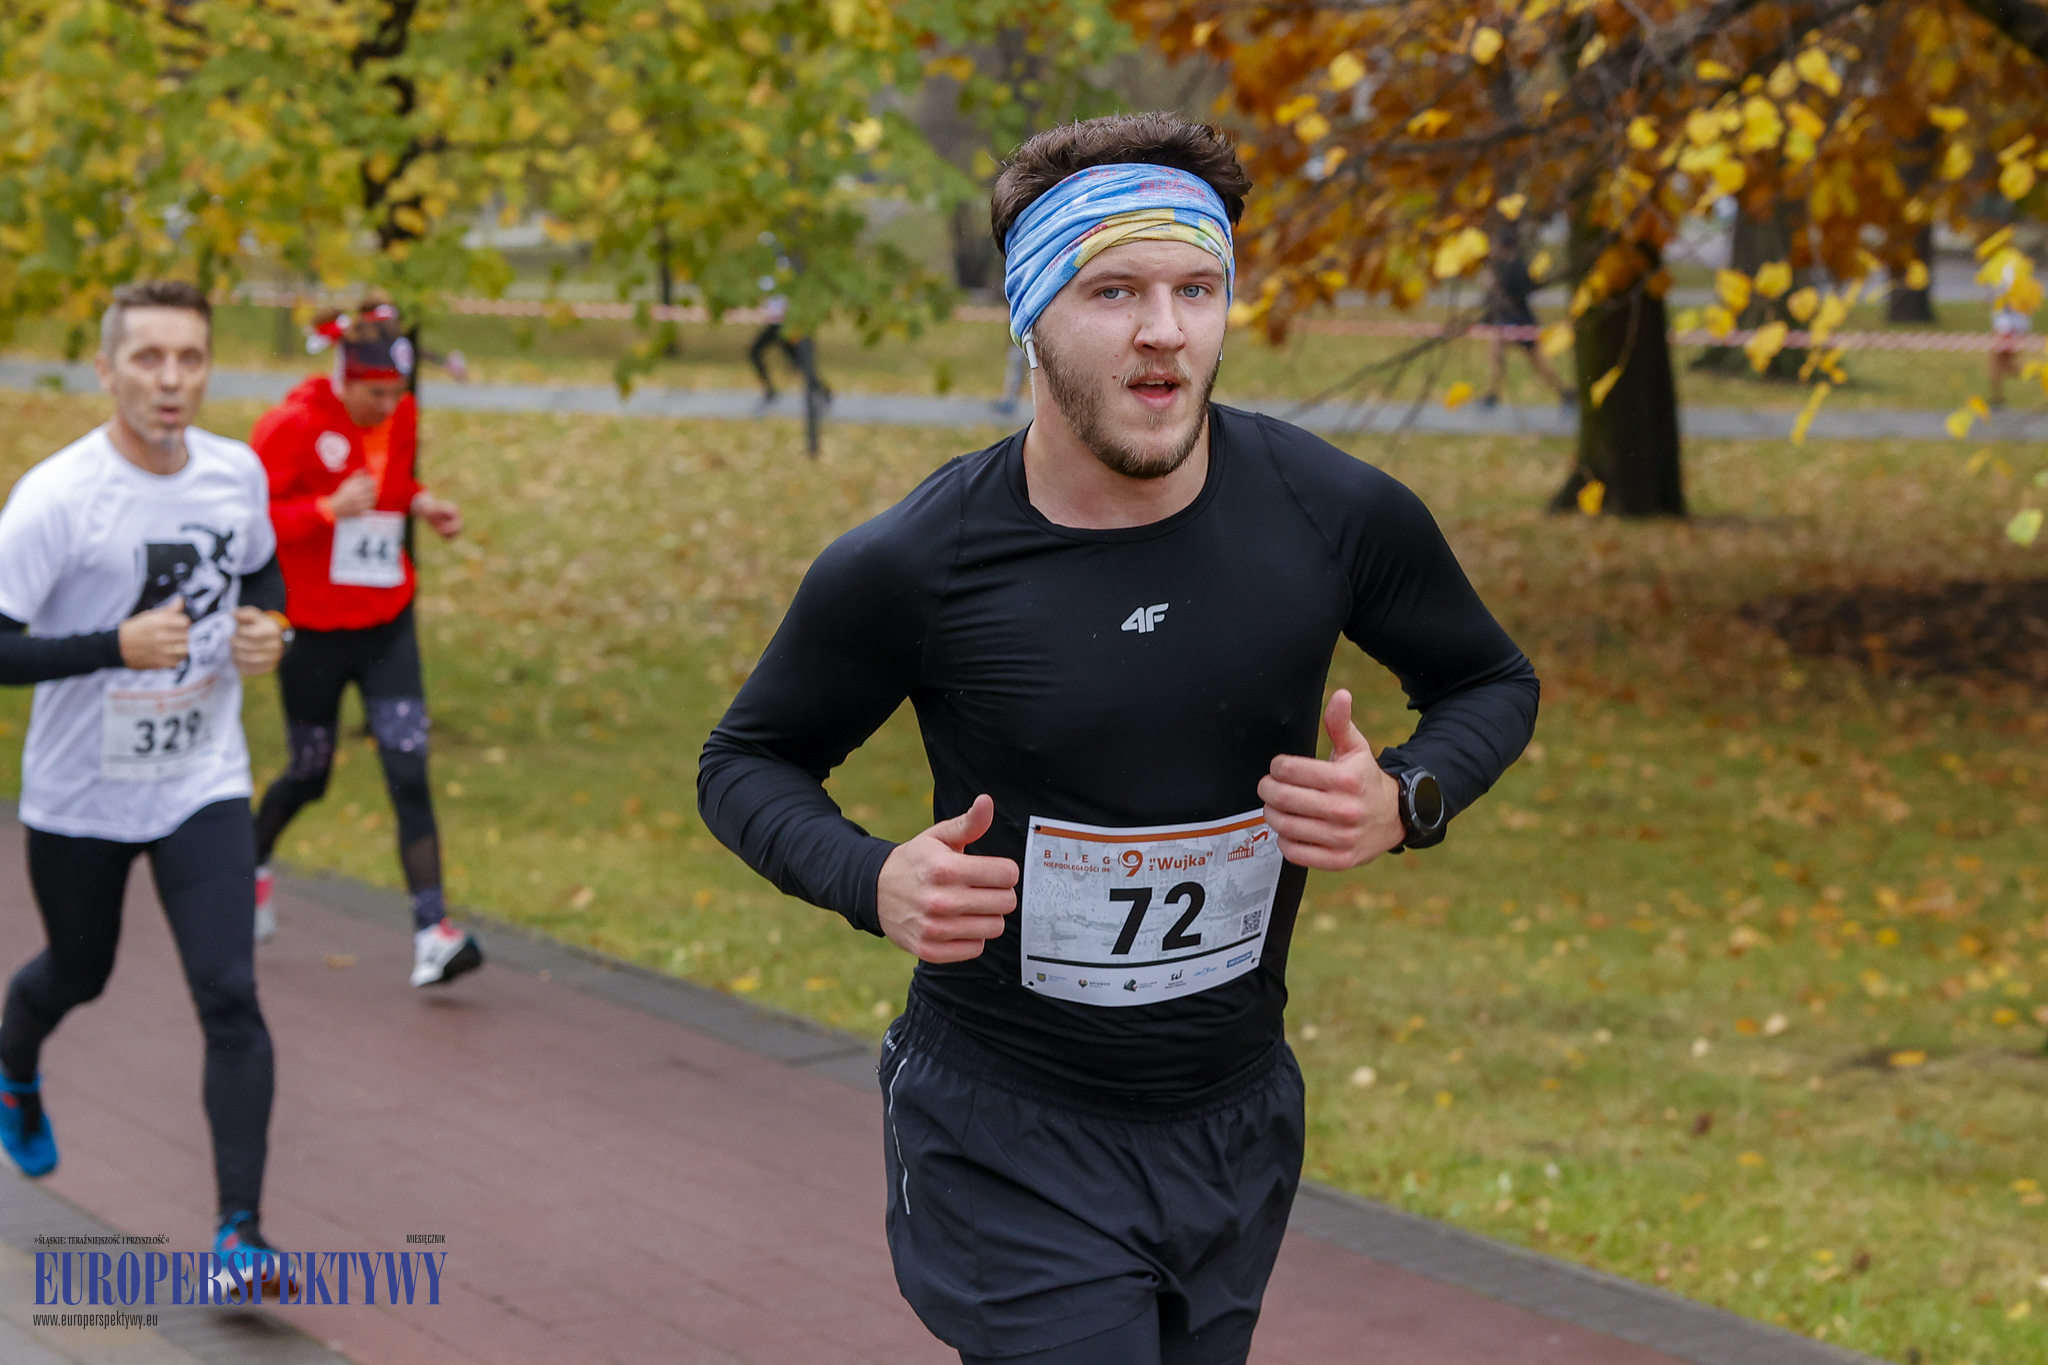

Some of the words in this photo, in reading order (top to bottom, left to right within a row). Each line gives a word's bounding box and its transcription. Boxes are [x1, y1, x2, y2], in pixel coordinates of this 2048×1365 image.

[1121, 603, 1169, 633] 4F
[133, 709, 204, 755] 329
[1044, 861, 1099, 872] NIEPODLEGŁOŚCI
[1118, 850, 1143, 877] 9
[1109, 881, 1206, 955] 72
